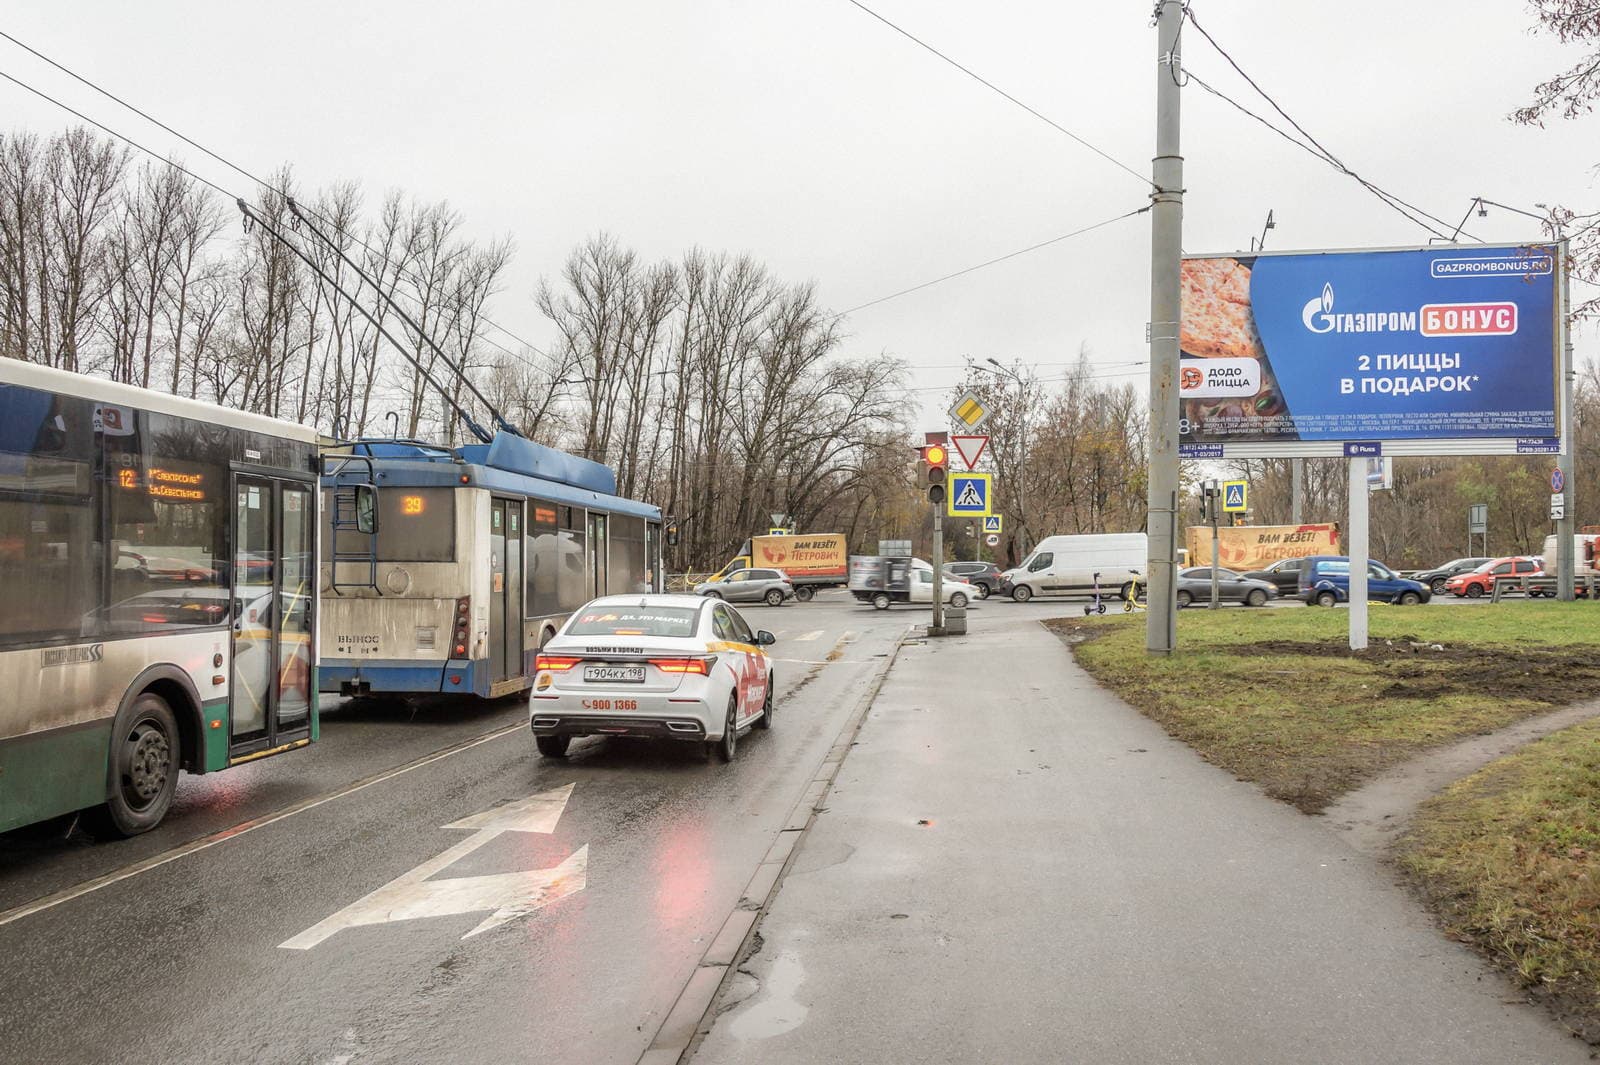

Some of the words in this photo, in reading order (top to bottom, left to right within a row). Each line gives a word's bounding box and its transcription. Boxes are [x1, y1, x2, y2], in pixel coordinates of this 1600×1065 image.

[1336, 311, 1416, 333] ГАЗПРОМ
[1427, 308, 1511, 331] БОНУС
[1358, 354, 1370, 371] 2
[1376, 352, 1460, 373] ПИЦЦЫ
[1208, 367, 1242, 378] ДОДО
[1208, 377, 1250, 388] ПИЦЦА
[1340, 378, 1355, 394] В
[403, 496, 423, 515] 39
[1258, 534, 1280, 544] ВАМ
[794, 541, 811, 549] ВАМ
[654, 615, 689, 625] МАРКЕТ
[338, 635, 379, 643] ВЫНОС
[627, 668, 642, 677] 198
[592, 699, 611, 710] 900
[614, 699, 637, 710] 1366
